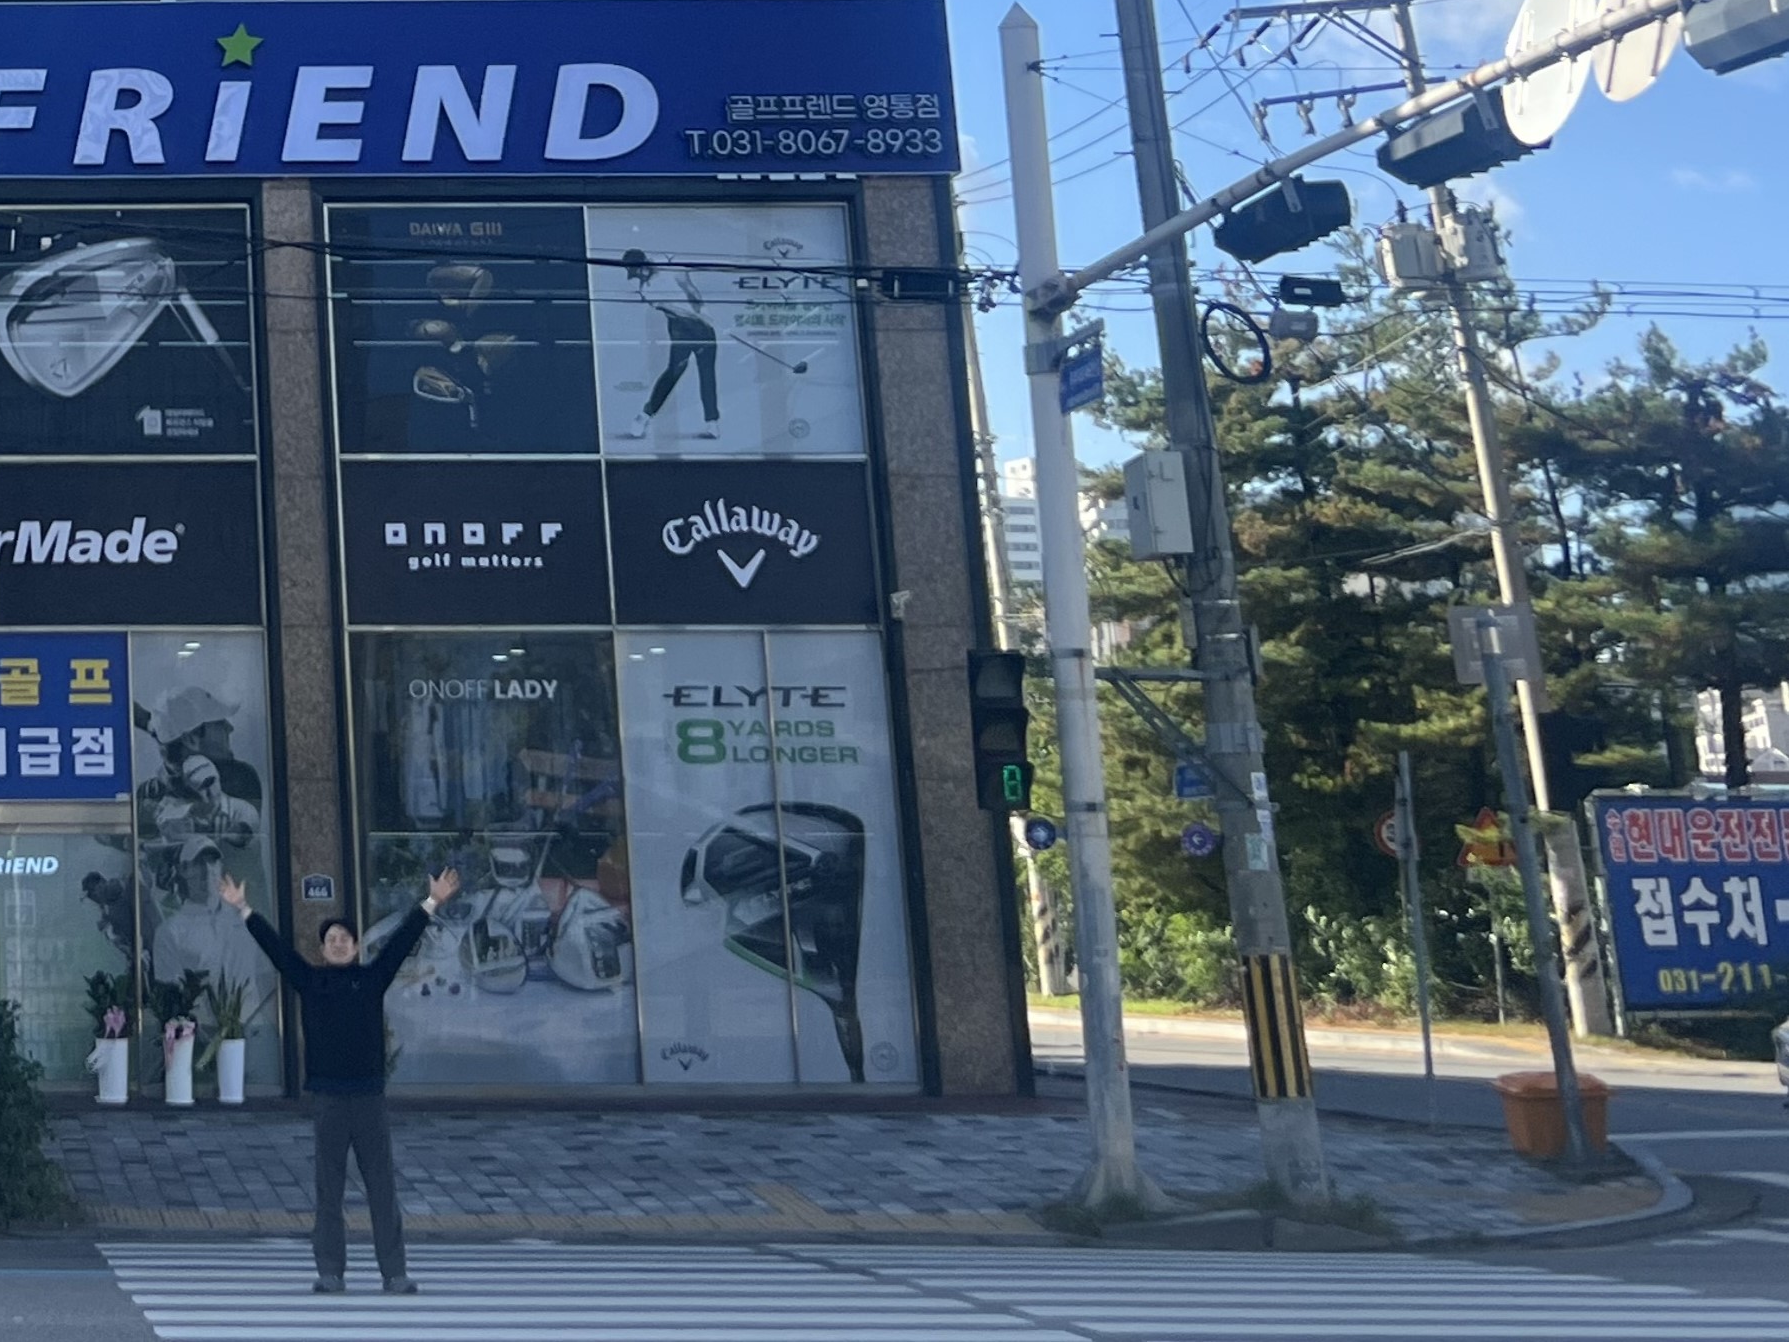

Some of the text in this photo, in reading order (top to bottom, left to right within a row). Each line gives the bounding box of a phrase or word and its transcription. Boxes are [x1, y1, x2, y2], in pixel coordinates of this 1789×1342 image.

[726, 93, 942, 121] 골프프렌드 영통점
[685, 128, 944, 156] T.031-8067-8933
[661, 497, 820, 558] Callaway
[408, 552, 544, 571] golf matters
[409, 679, 559, 700] ONOFF LADY
[663, 685, 847, 707] ELYTE
[676, 718, 836, 765] 8 YARDS
[732, 745, 859, 764] LONGER
[1623, 808, 1789, 862] 현대운전전
[1631, 877, 1769, 947] 접수처
